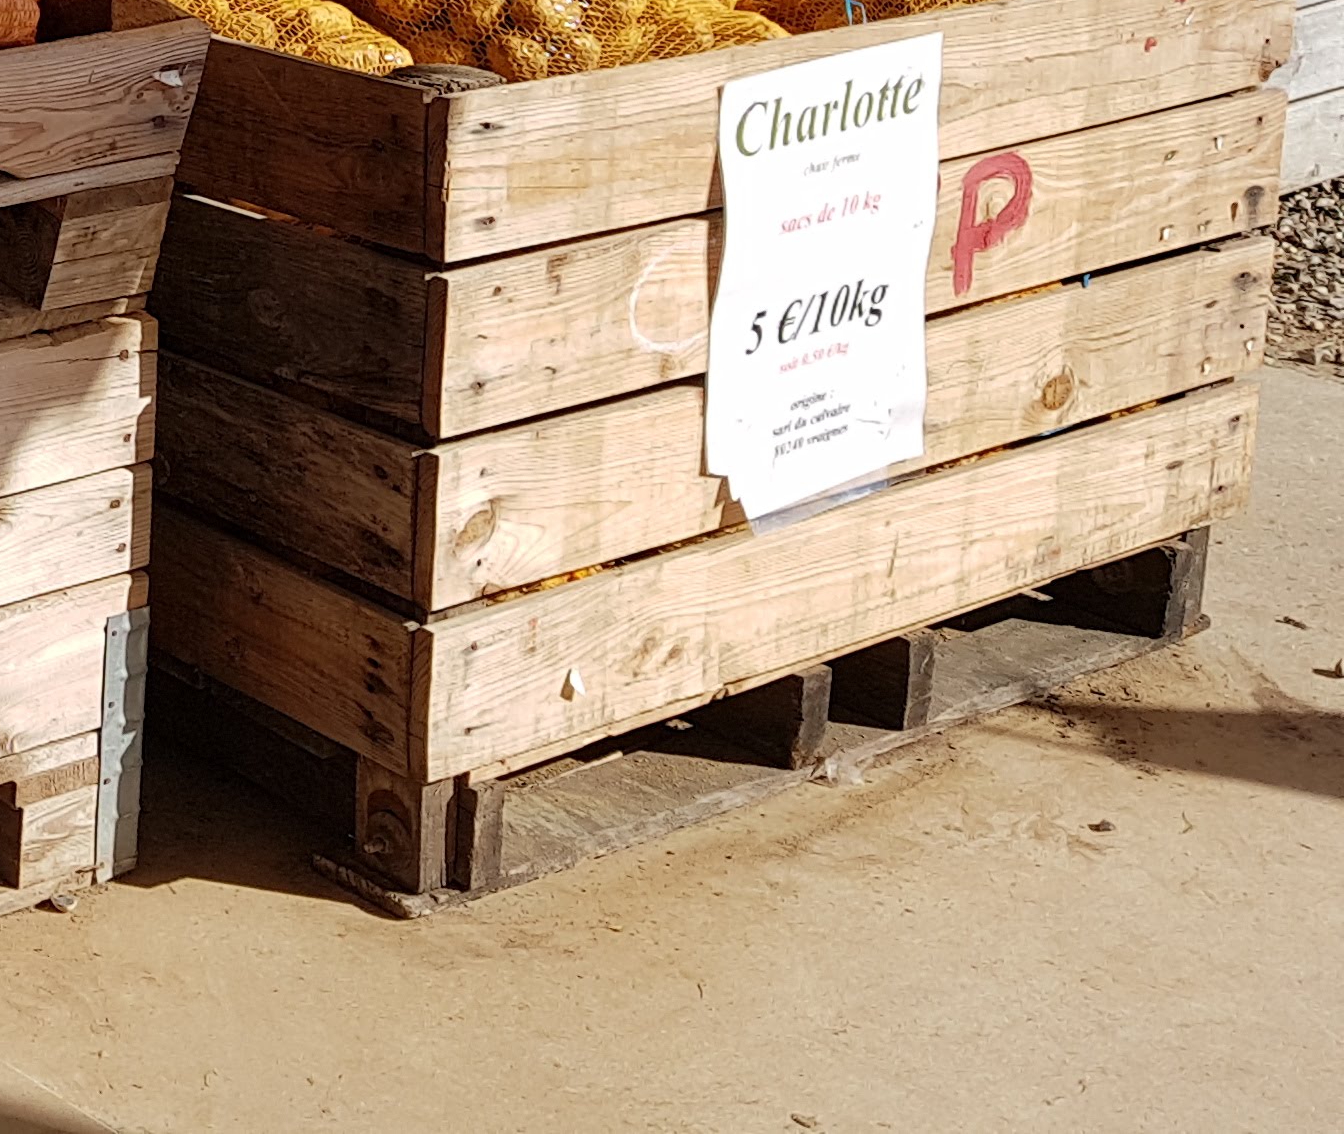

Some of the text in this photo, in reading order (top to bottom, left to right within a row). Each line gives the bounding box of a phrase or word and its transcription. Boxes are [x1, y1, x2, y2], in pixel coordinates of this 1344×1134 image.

[735, 72, 926, 157] Charlotte
[779, 190, 882, 236] sacs de 10 kg
[950, 150, 1033, 297] P
[745, 278, 890, 356] 5 €/10kg
